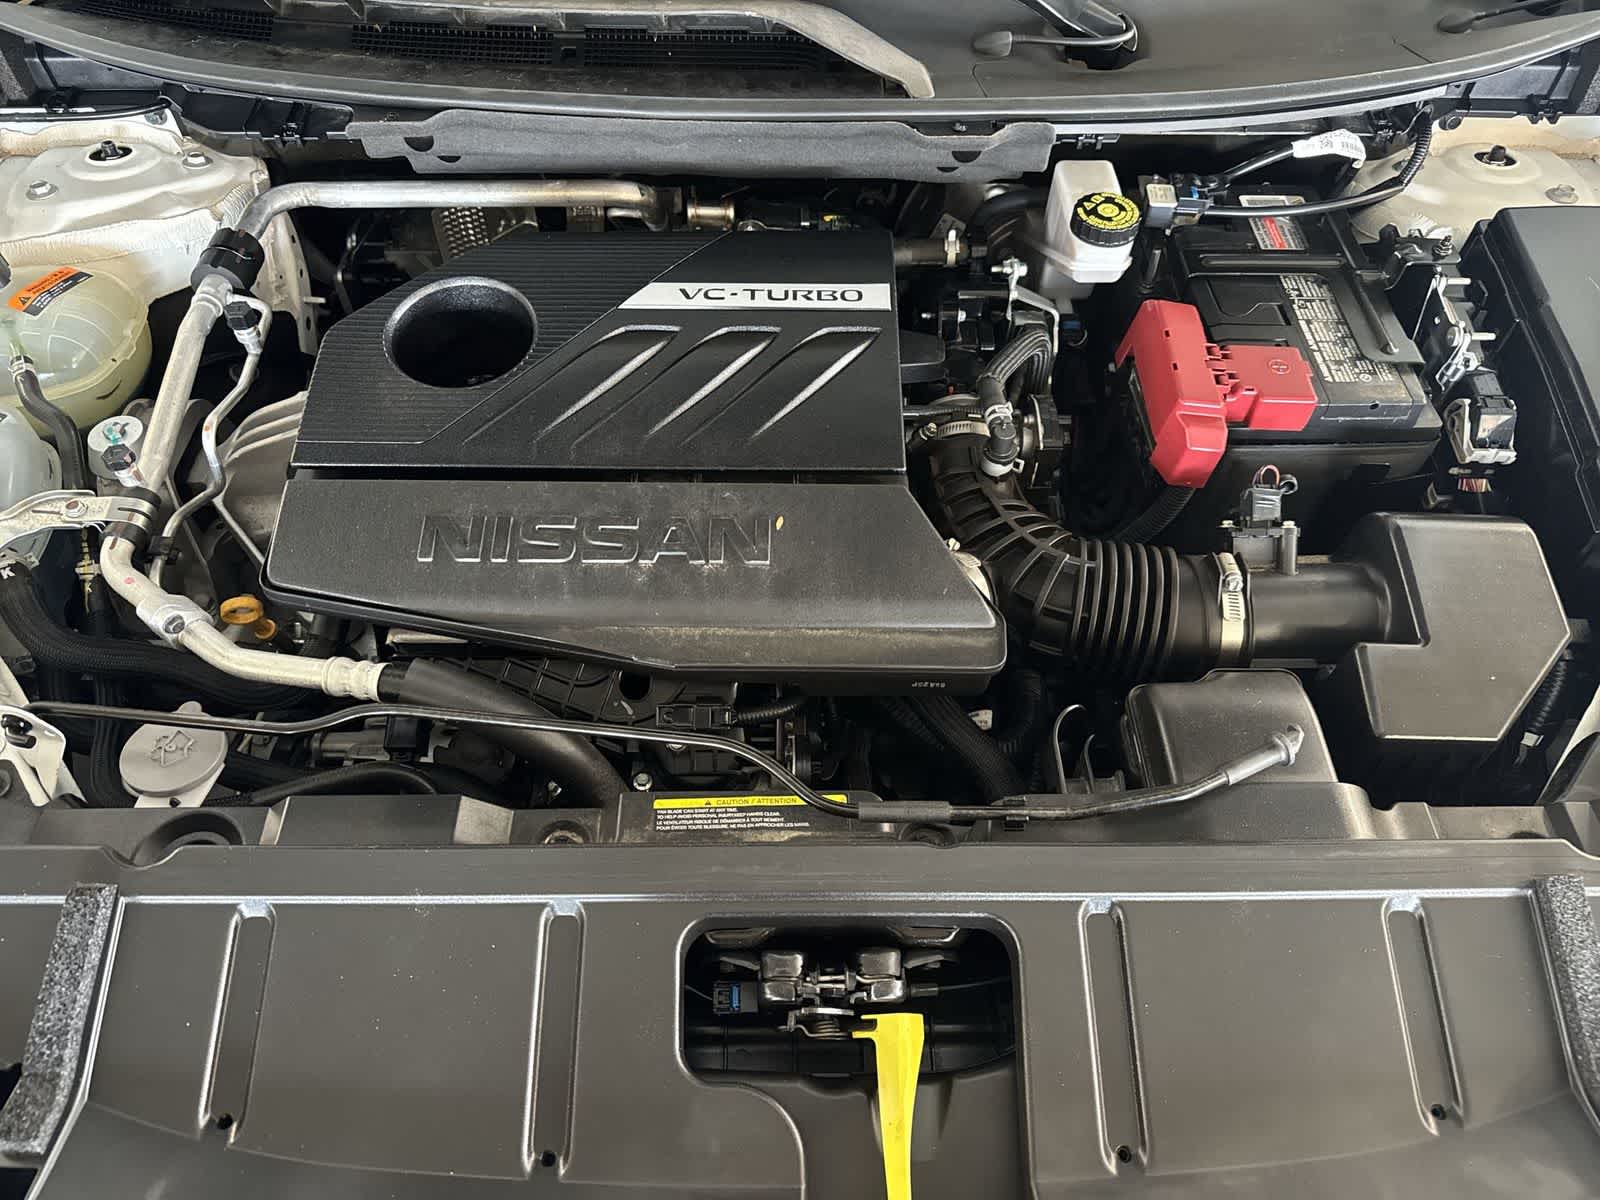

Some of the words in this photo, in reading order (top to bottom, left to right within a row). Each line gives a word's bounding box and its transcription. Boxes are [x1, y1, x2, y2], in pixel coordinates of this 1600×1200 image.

[679, 288, 863, 302] VC-TURBO
[416, 515, 771, 564] NISSAN
[716, 798, 749, 806] CAUTION
[757, 797, 798, 805] ATTENTION
